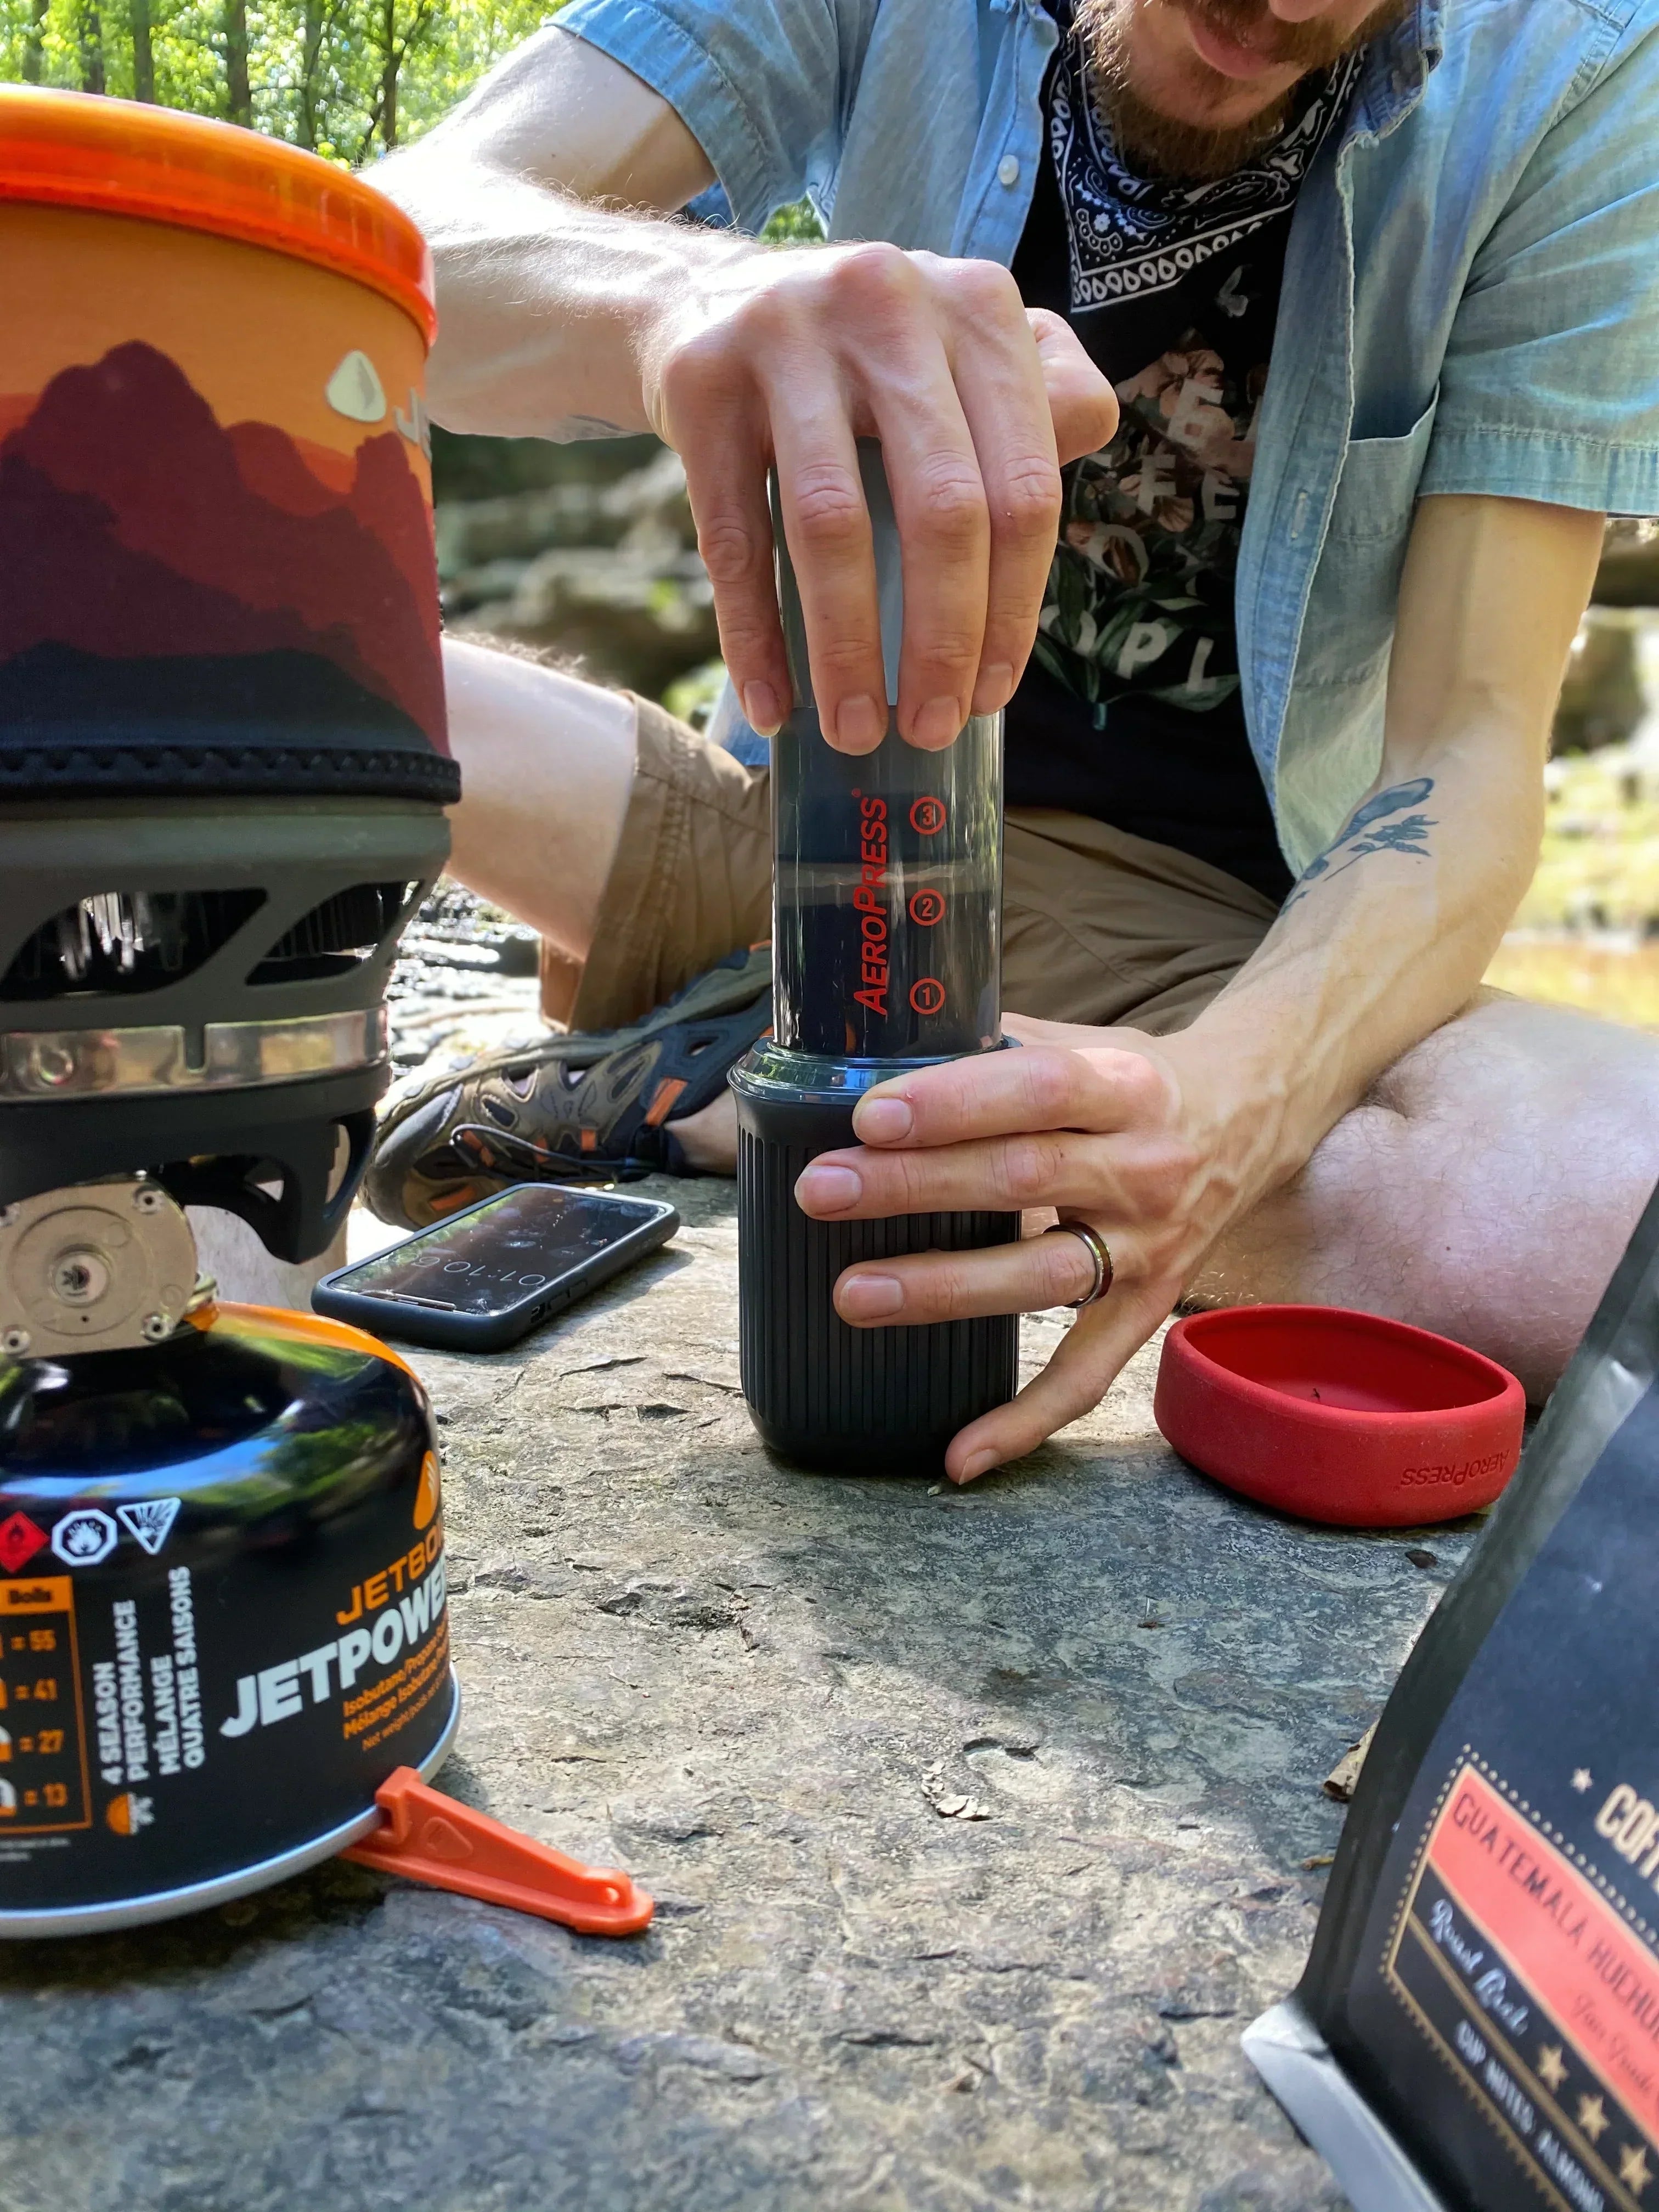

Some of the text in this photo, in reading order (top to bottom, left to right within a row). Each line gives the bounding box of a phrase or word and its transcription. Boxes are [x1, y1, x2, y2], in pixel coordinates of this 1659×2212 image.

[92, 1661, 124, 1785] 4 SEASON
[112, 1599, 150, 1783] PERFORMANCE
[150, 1655, 182, 1776] MÉLANGE
[168, 1566, 205, 1769] QUATRE SAISONS
[38, 1729, 65, 1754] 27
[43, 1782, 69, 1807] 13
[1453, 1792, 1589, 1950] GUATEMALA
